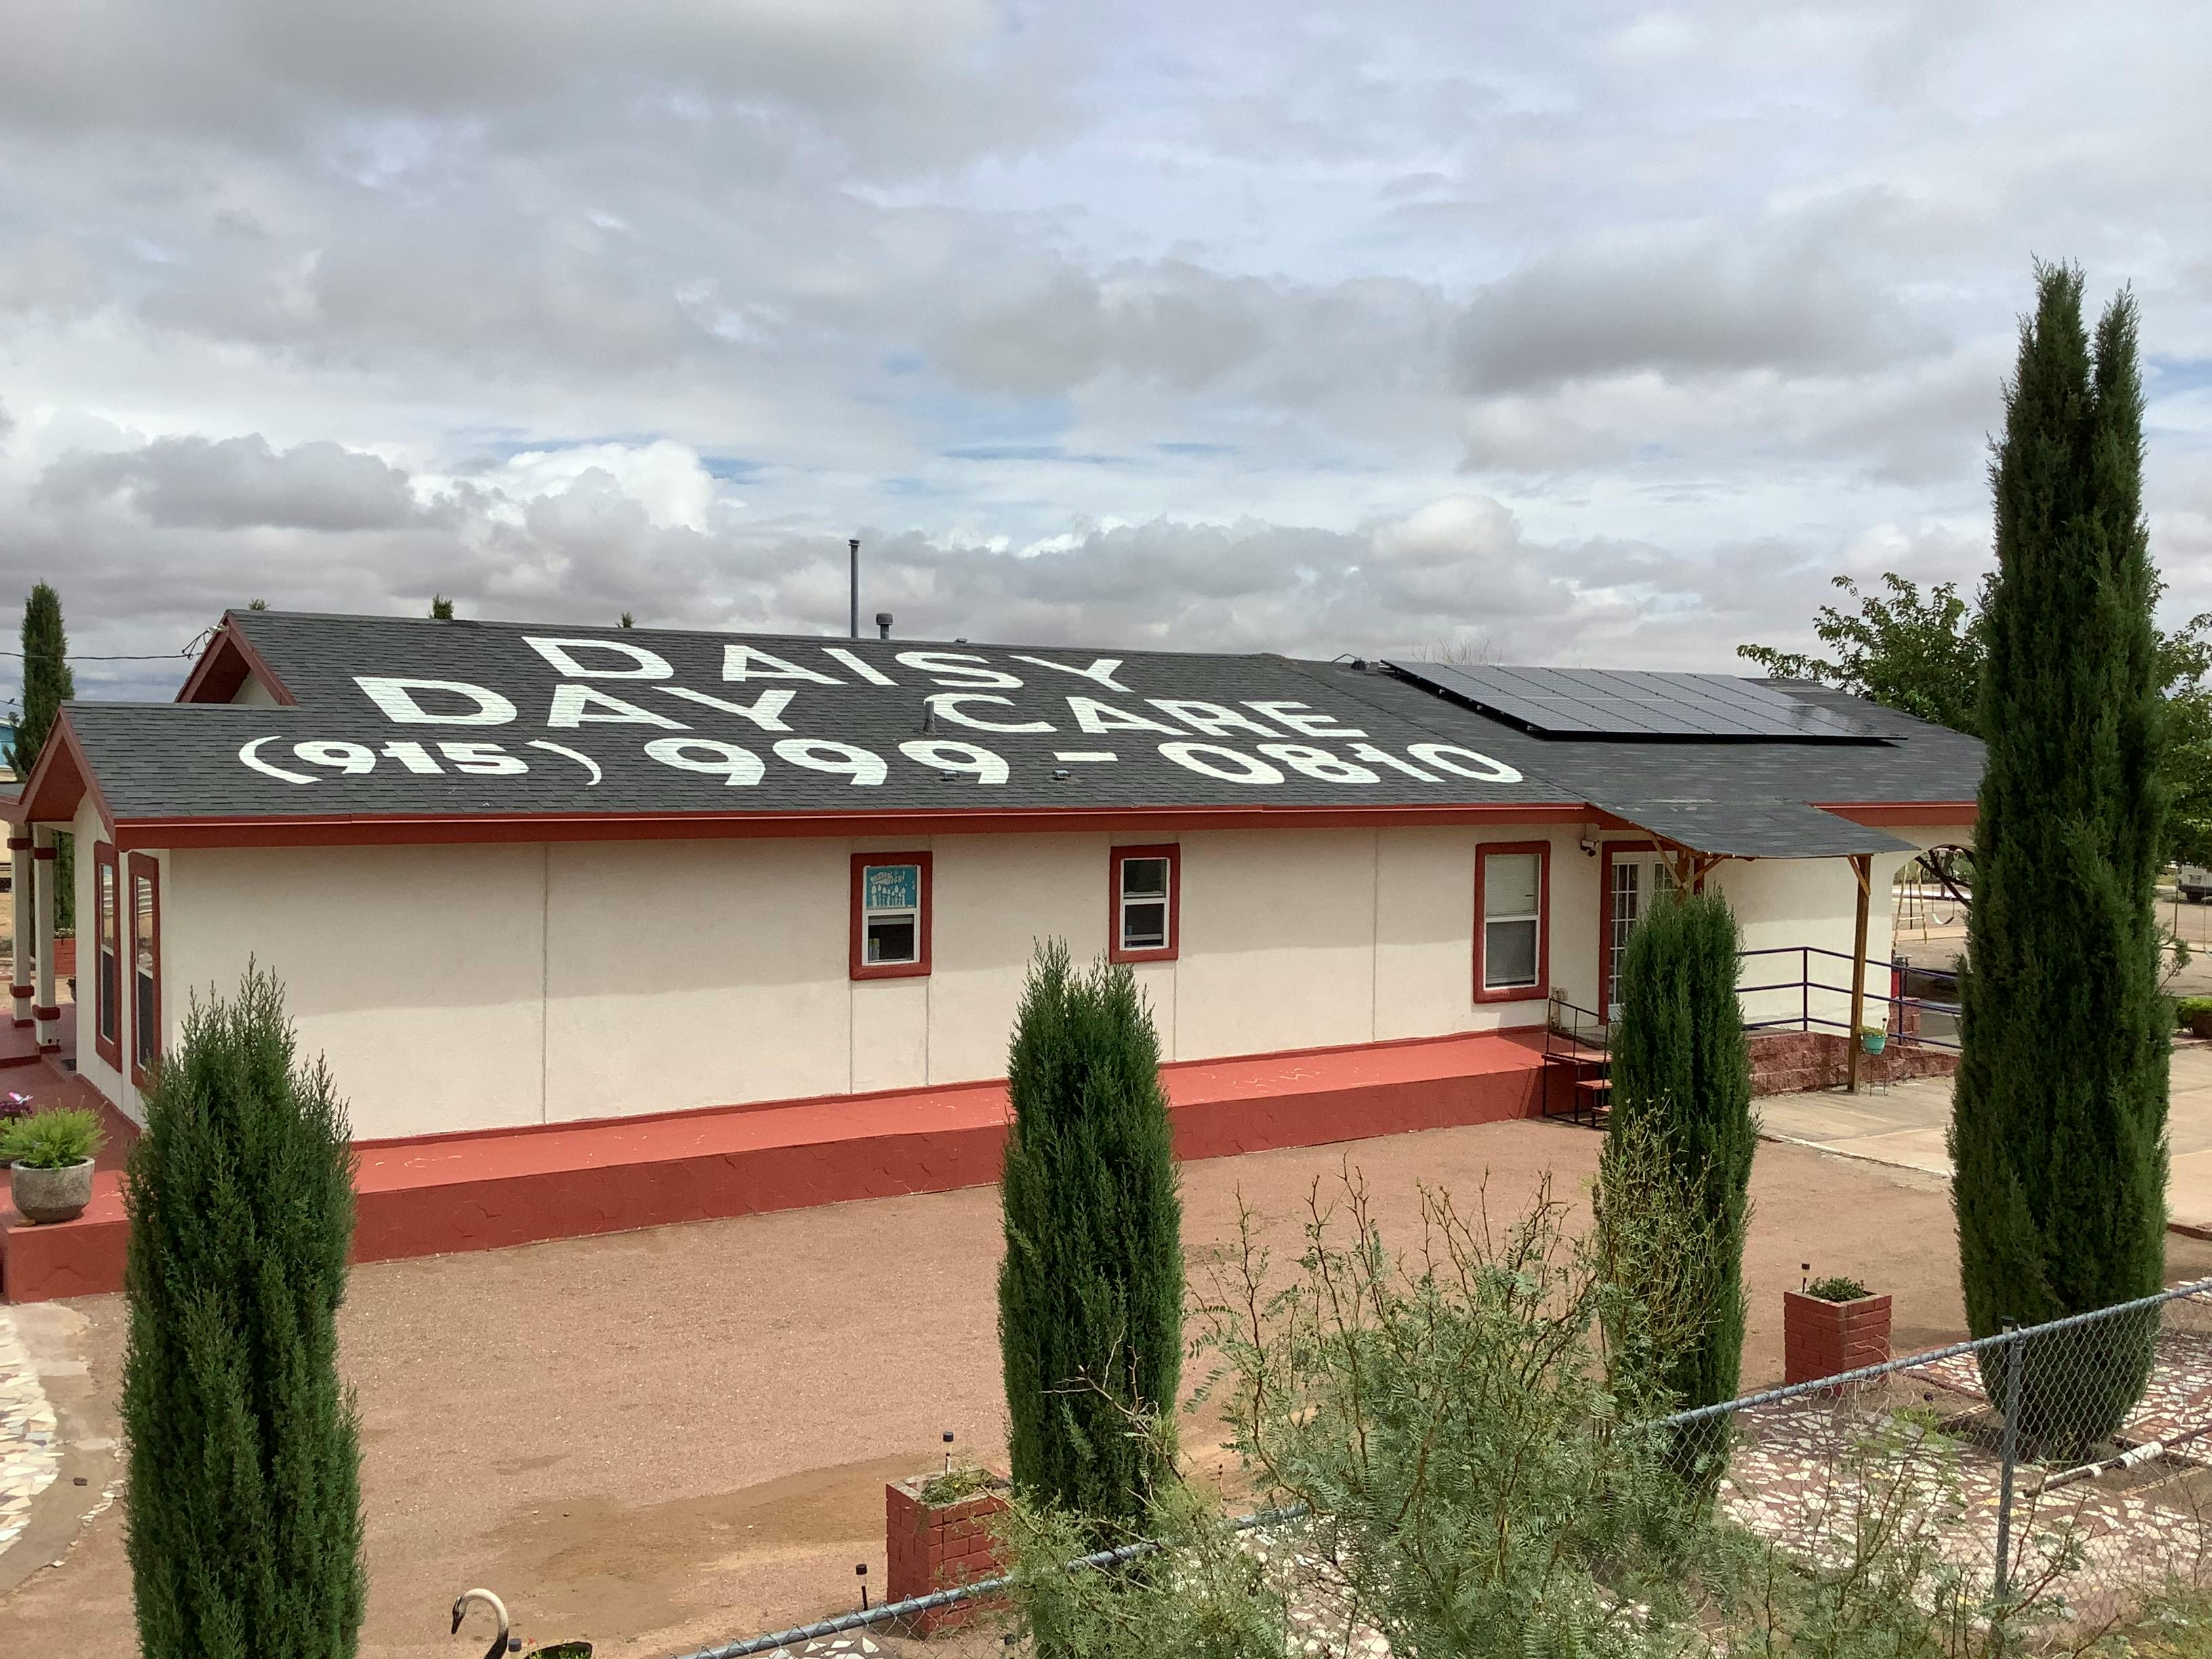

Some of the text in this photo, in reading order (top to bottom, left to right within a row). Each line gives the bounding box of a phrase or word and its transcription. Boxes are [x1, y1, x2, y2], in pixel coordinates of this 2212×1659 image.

[522, 636, 1133, 693] DAISY
[352, 676, 1369, 738] DAY CARE
[239, 735, 602, 785] (915)
[644, 737, 1010, 785] 999
[1158, 741, 1523, 785] 0810
